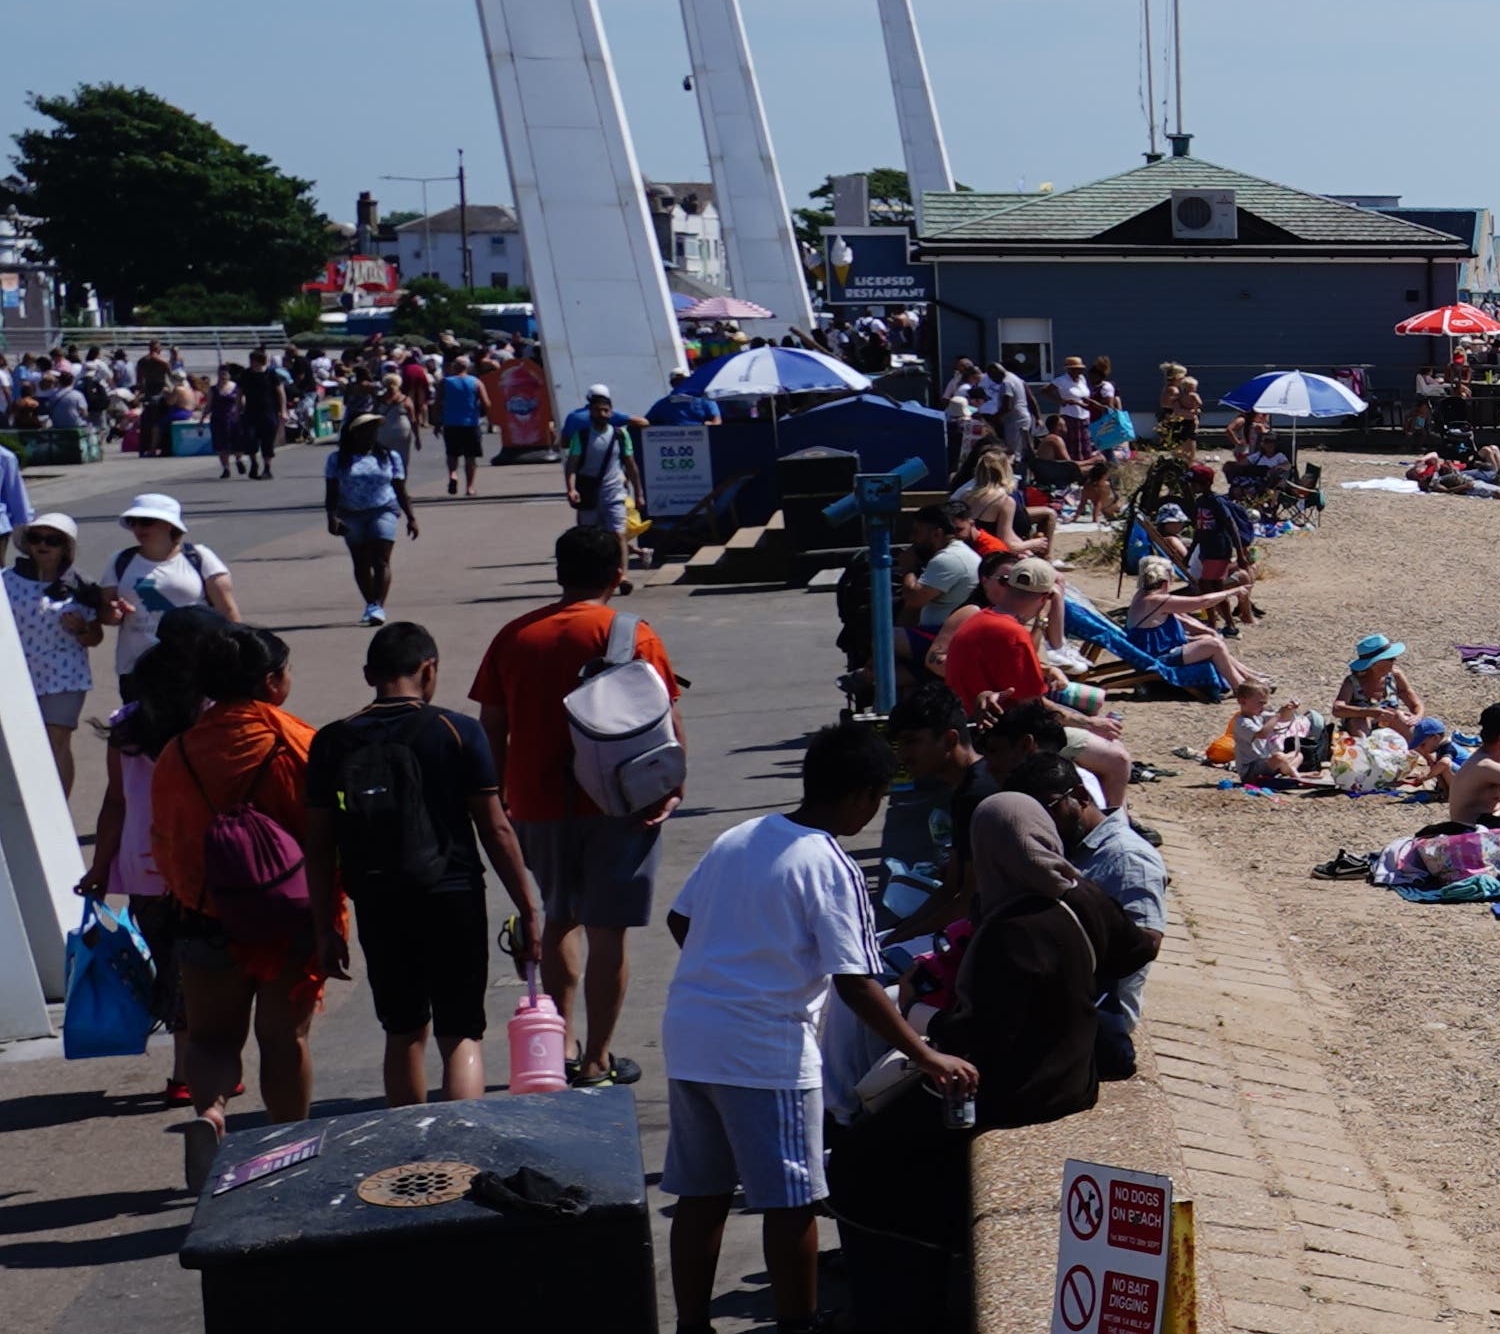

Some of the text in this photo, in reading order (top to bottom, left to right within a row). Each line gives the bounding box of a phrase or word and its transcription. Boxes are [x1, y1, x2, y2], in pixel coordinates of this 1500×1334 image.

[854, 276, 915, 286] LICENSED
[844, 288, 926, 298] RESTAURANT
[660, 445, 694, 457] £6.00
[662, 458, 695, 470] £5.00
[1114, 1186, 1160, 1207] NO DOGS
[1111, 1206, 1126, 1221] ON
[1112, 1278, 1150, 1297] NO BAIT
[1109, 1294, 1149, 1314] DIGGING
[1107, 1326, 1117, 1334] THE
